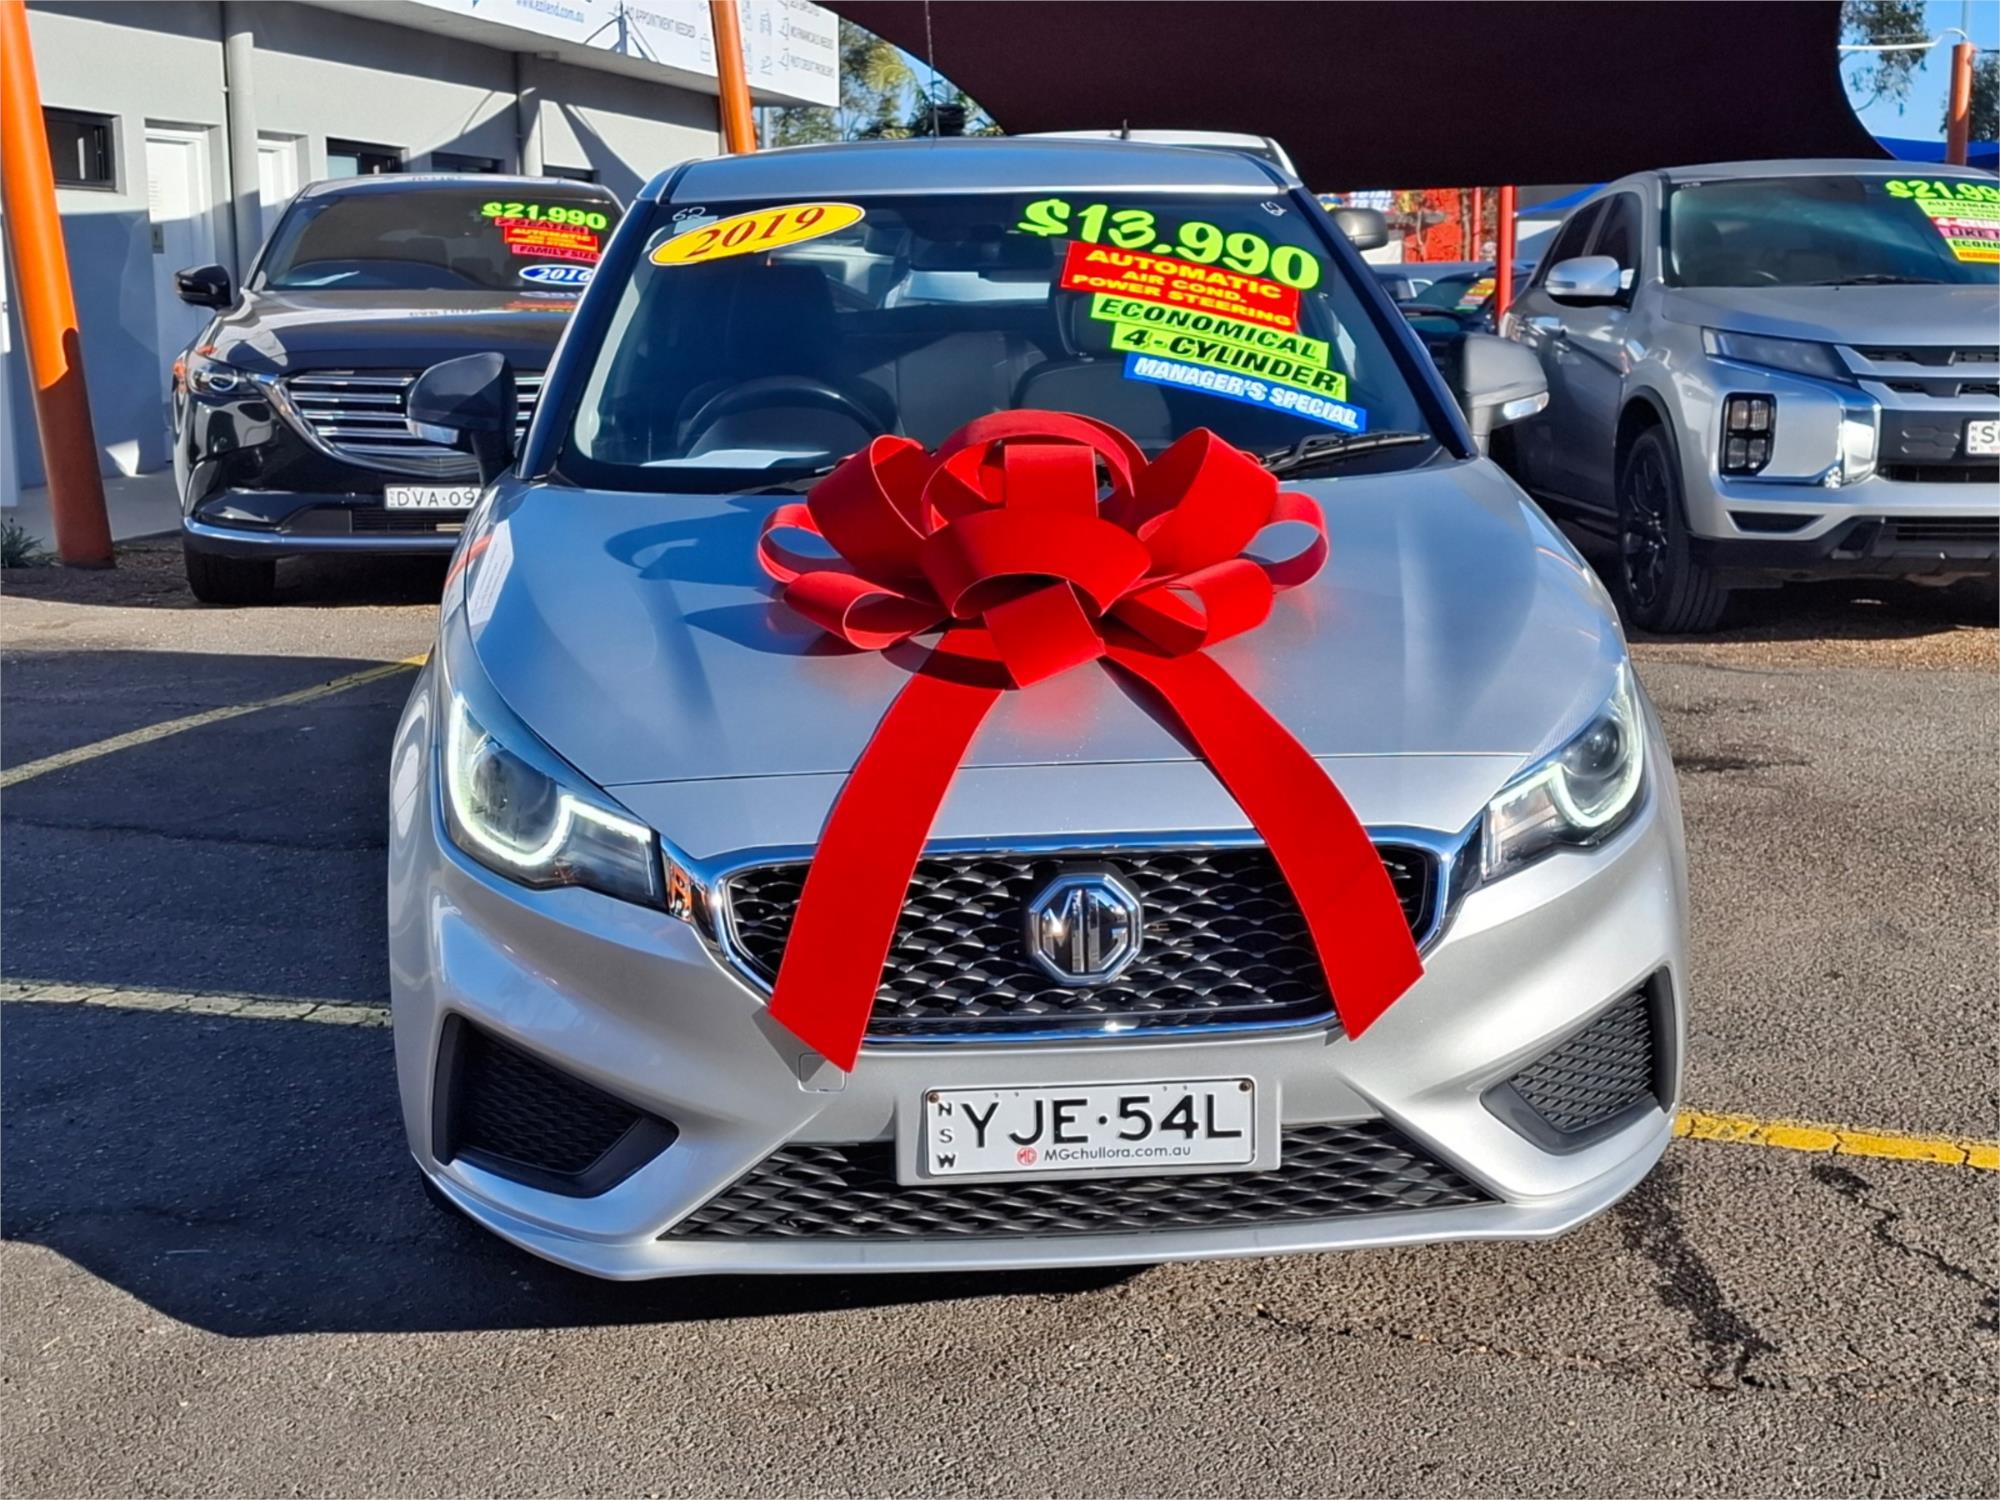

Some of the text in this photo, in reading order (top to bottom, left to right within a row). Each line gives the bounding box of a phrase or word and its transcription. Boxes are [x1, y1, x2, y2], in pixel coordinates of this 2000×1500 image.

[672, 206, 706, 221] 62
[684, 207, 825, 258] 2019
[519, 246, 598, 260] FAMILY SIZE
[1085, 250, 1282, 299] AUTOMATIC
[1071, 274, 1292, 326] POWER STEERING
[1121, 271, 1248, 304] AIR COND.
[1099, 298, 1320, 362] ECONOMICAL
[1133, 356, 1359, 429] MANAGER'S SPECIAL
[1041, 887, 1129, 974] MG
[1043, 1145, 1191, 1162] MGchullora.com.au
